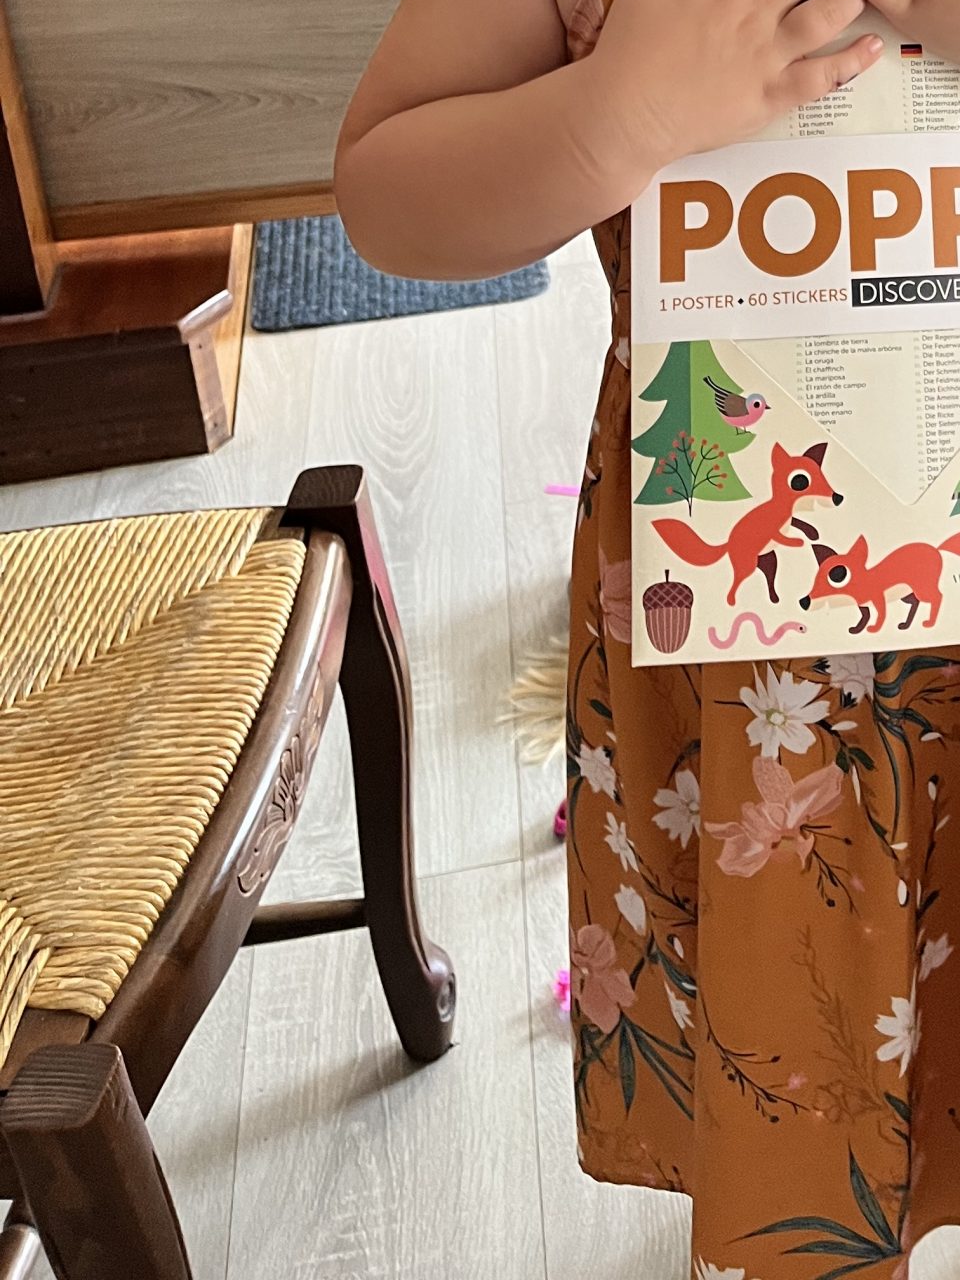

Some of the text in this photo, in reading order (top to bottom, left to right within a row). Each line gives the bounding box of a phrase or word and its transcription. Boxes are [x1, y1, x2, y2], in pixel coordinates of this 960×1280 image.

[659, 288, 848, 312] 1 POSTER 60 STICKERS
[922, 334, 933, 342] Der
[814, 375, 846, 383] mariposa
[843, 382, 867, 390] campo
